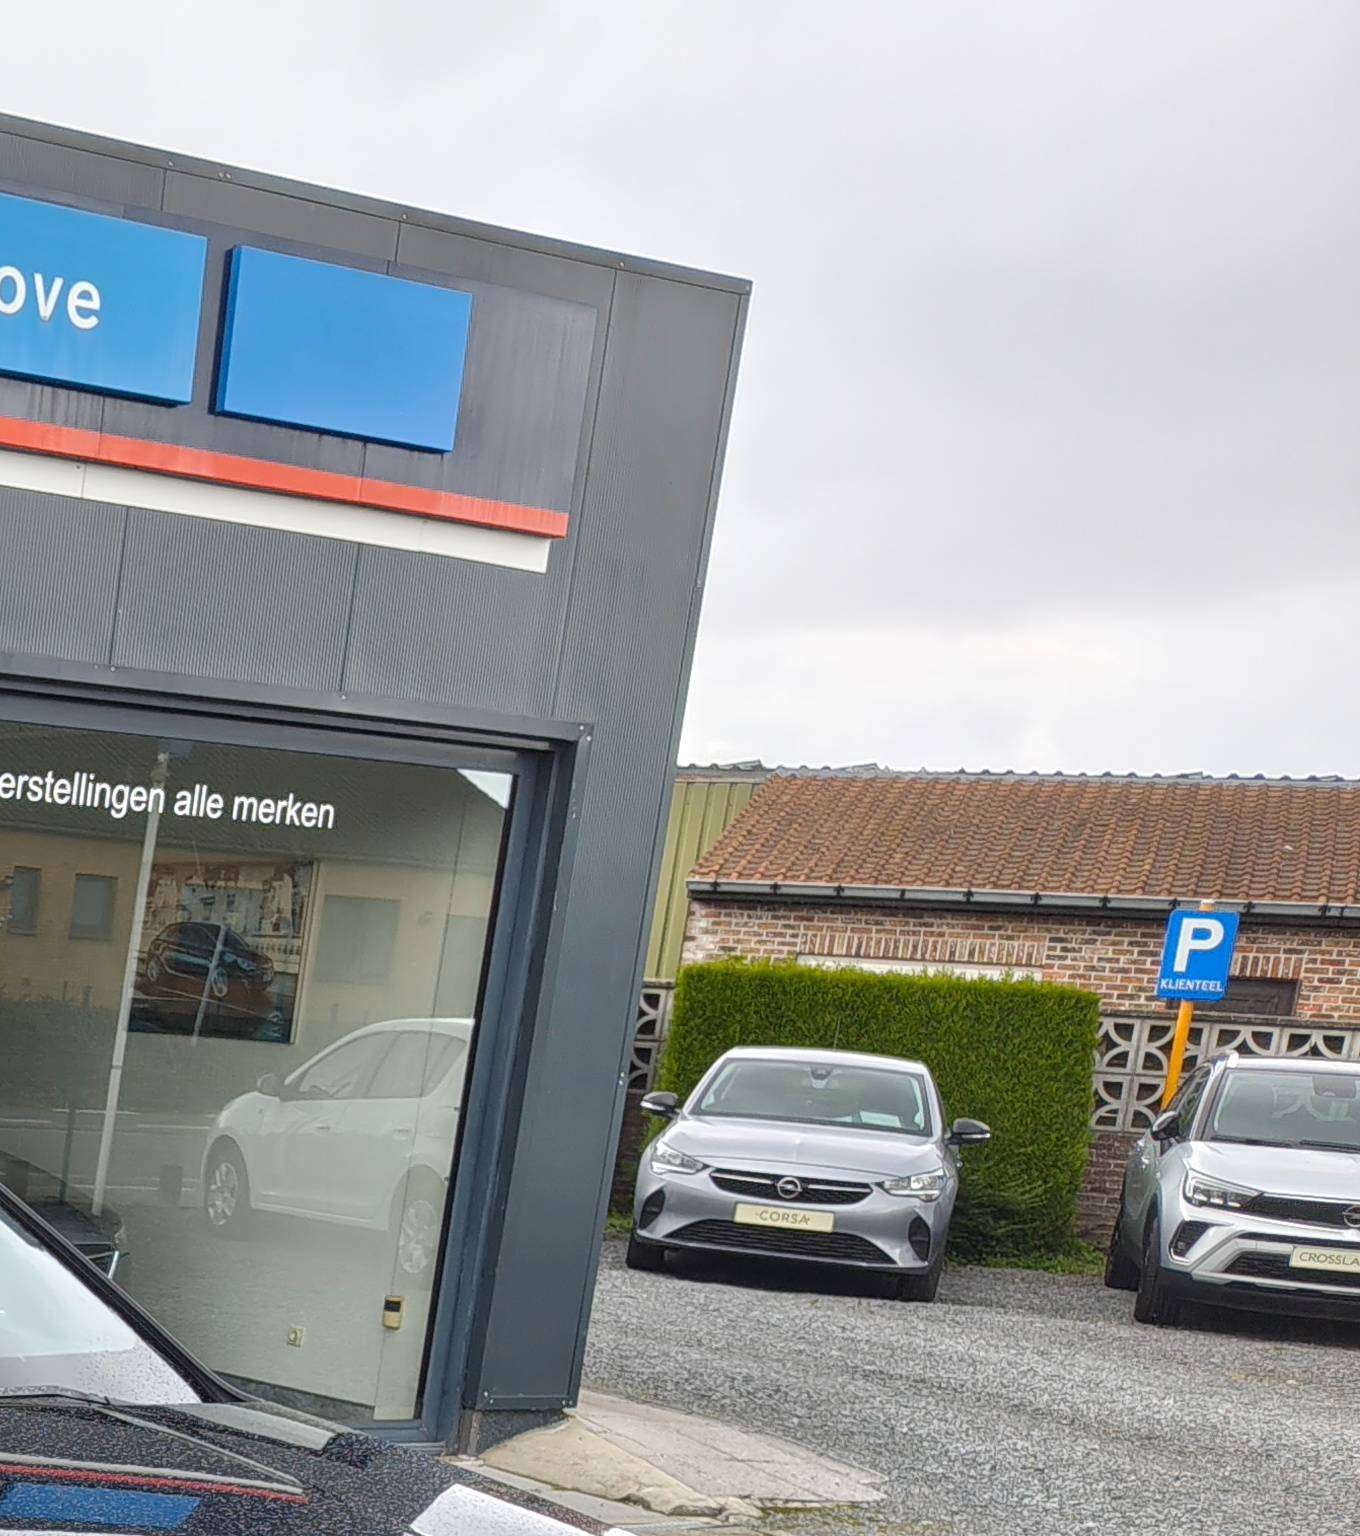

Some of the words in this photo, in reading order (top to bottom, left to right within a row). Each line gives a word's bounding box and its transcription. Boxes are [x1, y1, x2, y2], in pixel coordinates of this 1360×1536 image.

[174, 783, 223, 818] alle
[232, 793, 335, 829] merken
[1173, 917, 1224, 972] P
[1160, 978, 1224, 992] KLIENTEEL
